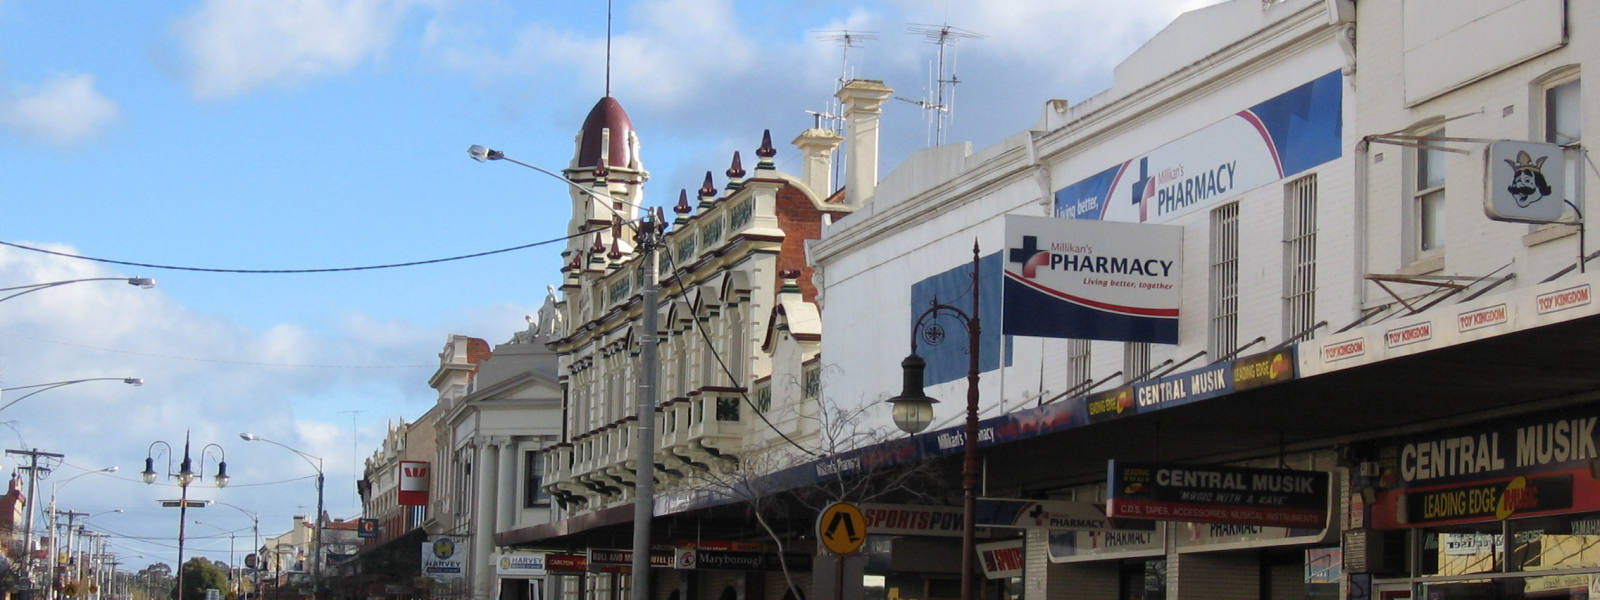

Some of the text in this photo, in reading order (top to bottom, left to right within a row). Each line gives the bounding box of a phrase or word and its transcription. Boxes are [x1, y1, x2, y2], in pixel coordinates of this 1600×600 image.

[1158, 164, 1184, 185] Millikan's
[1158, 160, 1237, 216] PHARMACY
[1077, 196, 1099, 215] better,
[1051, 242, 1093, 254] Millikan's
[1051, 254, 1173, 277] PHARMACY
[1083, 278, 1173, 291] Living better, together
[1538, 288, 1588, 309] TOY KINGDOM
[1459, 308, 1505, 328] TOY KINGDOM
[1389, 326, 1430, 344] TOY KINGDOM
[1325, 340, 1364, 359] TOY KINGDOM
[1138, 379, 1186, 407] CENTRAL
[1191, 368, 1226, 394] MUSIK
[1401, 417, 1598, 482] CENTRAL MUSIK
[1156, 468, 1314, 494] CENTRAL MUSIK
[1424, 490, 1466, 519] LEADING
[1469, 487, 1497, 514] EDGE
[1050, 518, 1105, 528] PHARMACY
